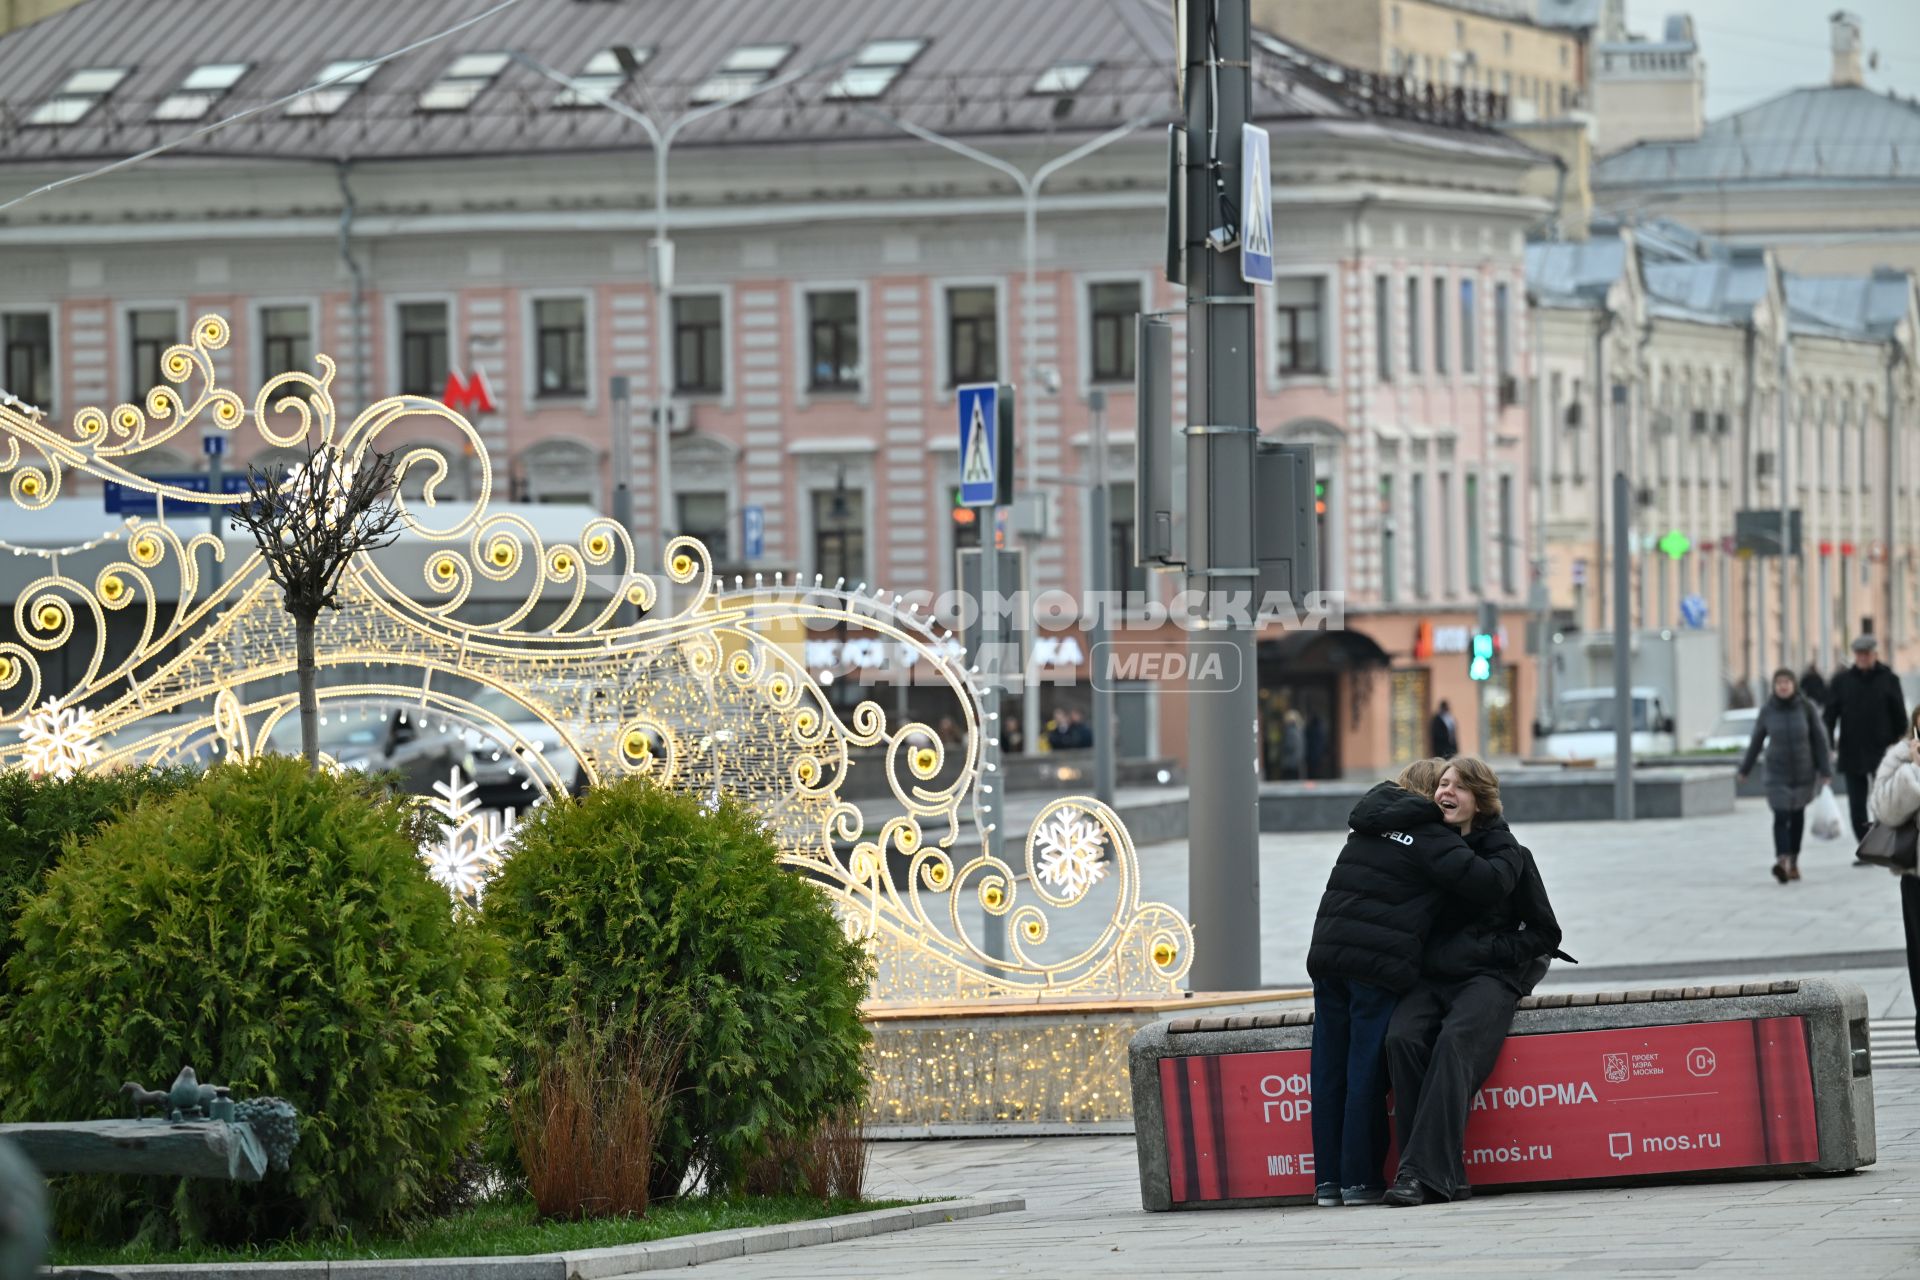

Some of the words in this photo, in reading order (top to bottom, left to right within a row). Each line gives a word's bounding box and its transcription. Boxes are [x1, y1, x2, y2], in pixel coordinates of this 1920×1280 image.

[1631, 1053, 1659, 1062] ПРОЕКТ
[1632, 1061, 1653, 1069] МЭРА
[1633, 1068, 1664, 1076] МОСКВЫ
[1470, 1081, 1599, 1111] АТФОРМА
[1642, 1133, 1721, 1153] mos.ru
[1462, 1144, 1553, 1165] .mos.ru
